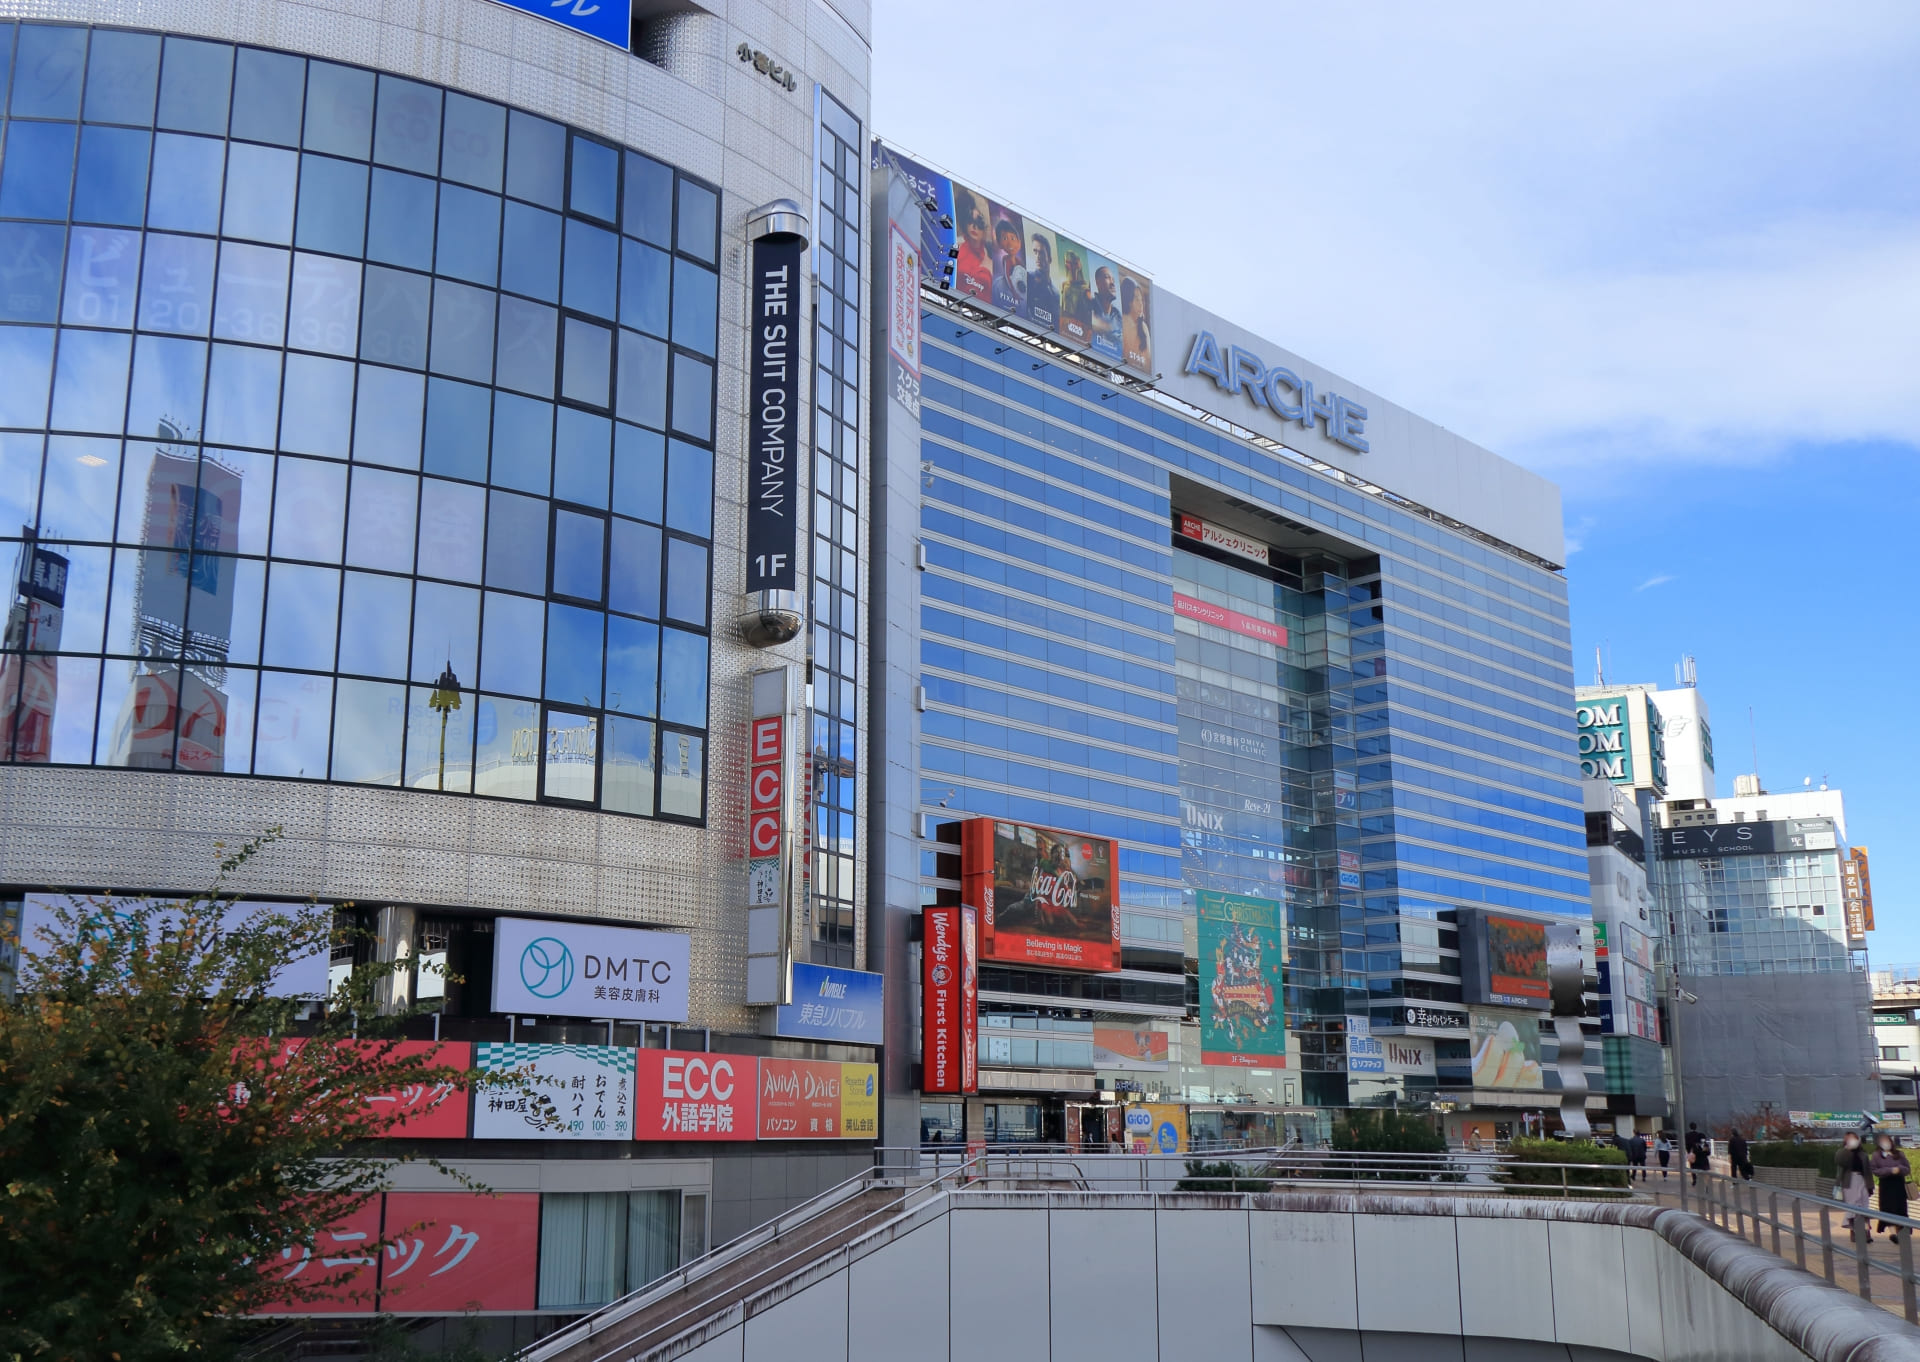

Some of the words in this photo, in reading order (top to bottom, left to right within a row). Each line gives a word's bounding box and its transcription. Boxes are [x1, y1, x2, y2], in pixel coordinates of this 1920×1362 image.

[764, 264, 788, 317] THE
[763, 323, 788, 382] SUIT
[1185, 330, 1370, 454] ARCHE
[761, 387, 787, 518] COMPANY
[1203, 527, 1268, 559] アルシェクリニック
[755, 553, 787, 578] 1F
[753, 721, 779, 852] ECC
[1673, 847, 1709, 855] MUSIC
[931, 912, 952, 963] Wendy's
[1063, 943, 1083, 954] Magic
[584, 954, 672, 985] DMTC
[593, 985, 660, 1003] 美容皮膚科
[936, 989, 947, 1025] First
[936, 1028, 947, 1088] Kitchen
[1389, 1042, 1422, 1066] UNIX
[662, 1056, 735, 1101] ECC
[487, 1097, 529, 1113] 神田屋
[571, 1074, 586, 1117] 酎ハイ
[594, 1074, 607, 1119] おでん
[614, 1120, 628, 1131] 390
[661, 1103, 735, 1134] 外語学院
[766, 1118, 797, 1132] パソコン
[845, 1118, 874, 1133] 英仏会話
